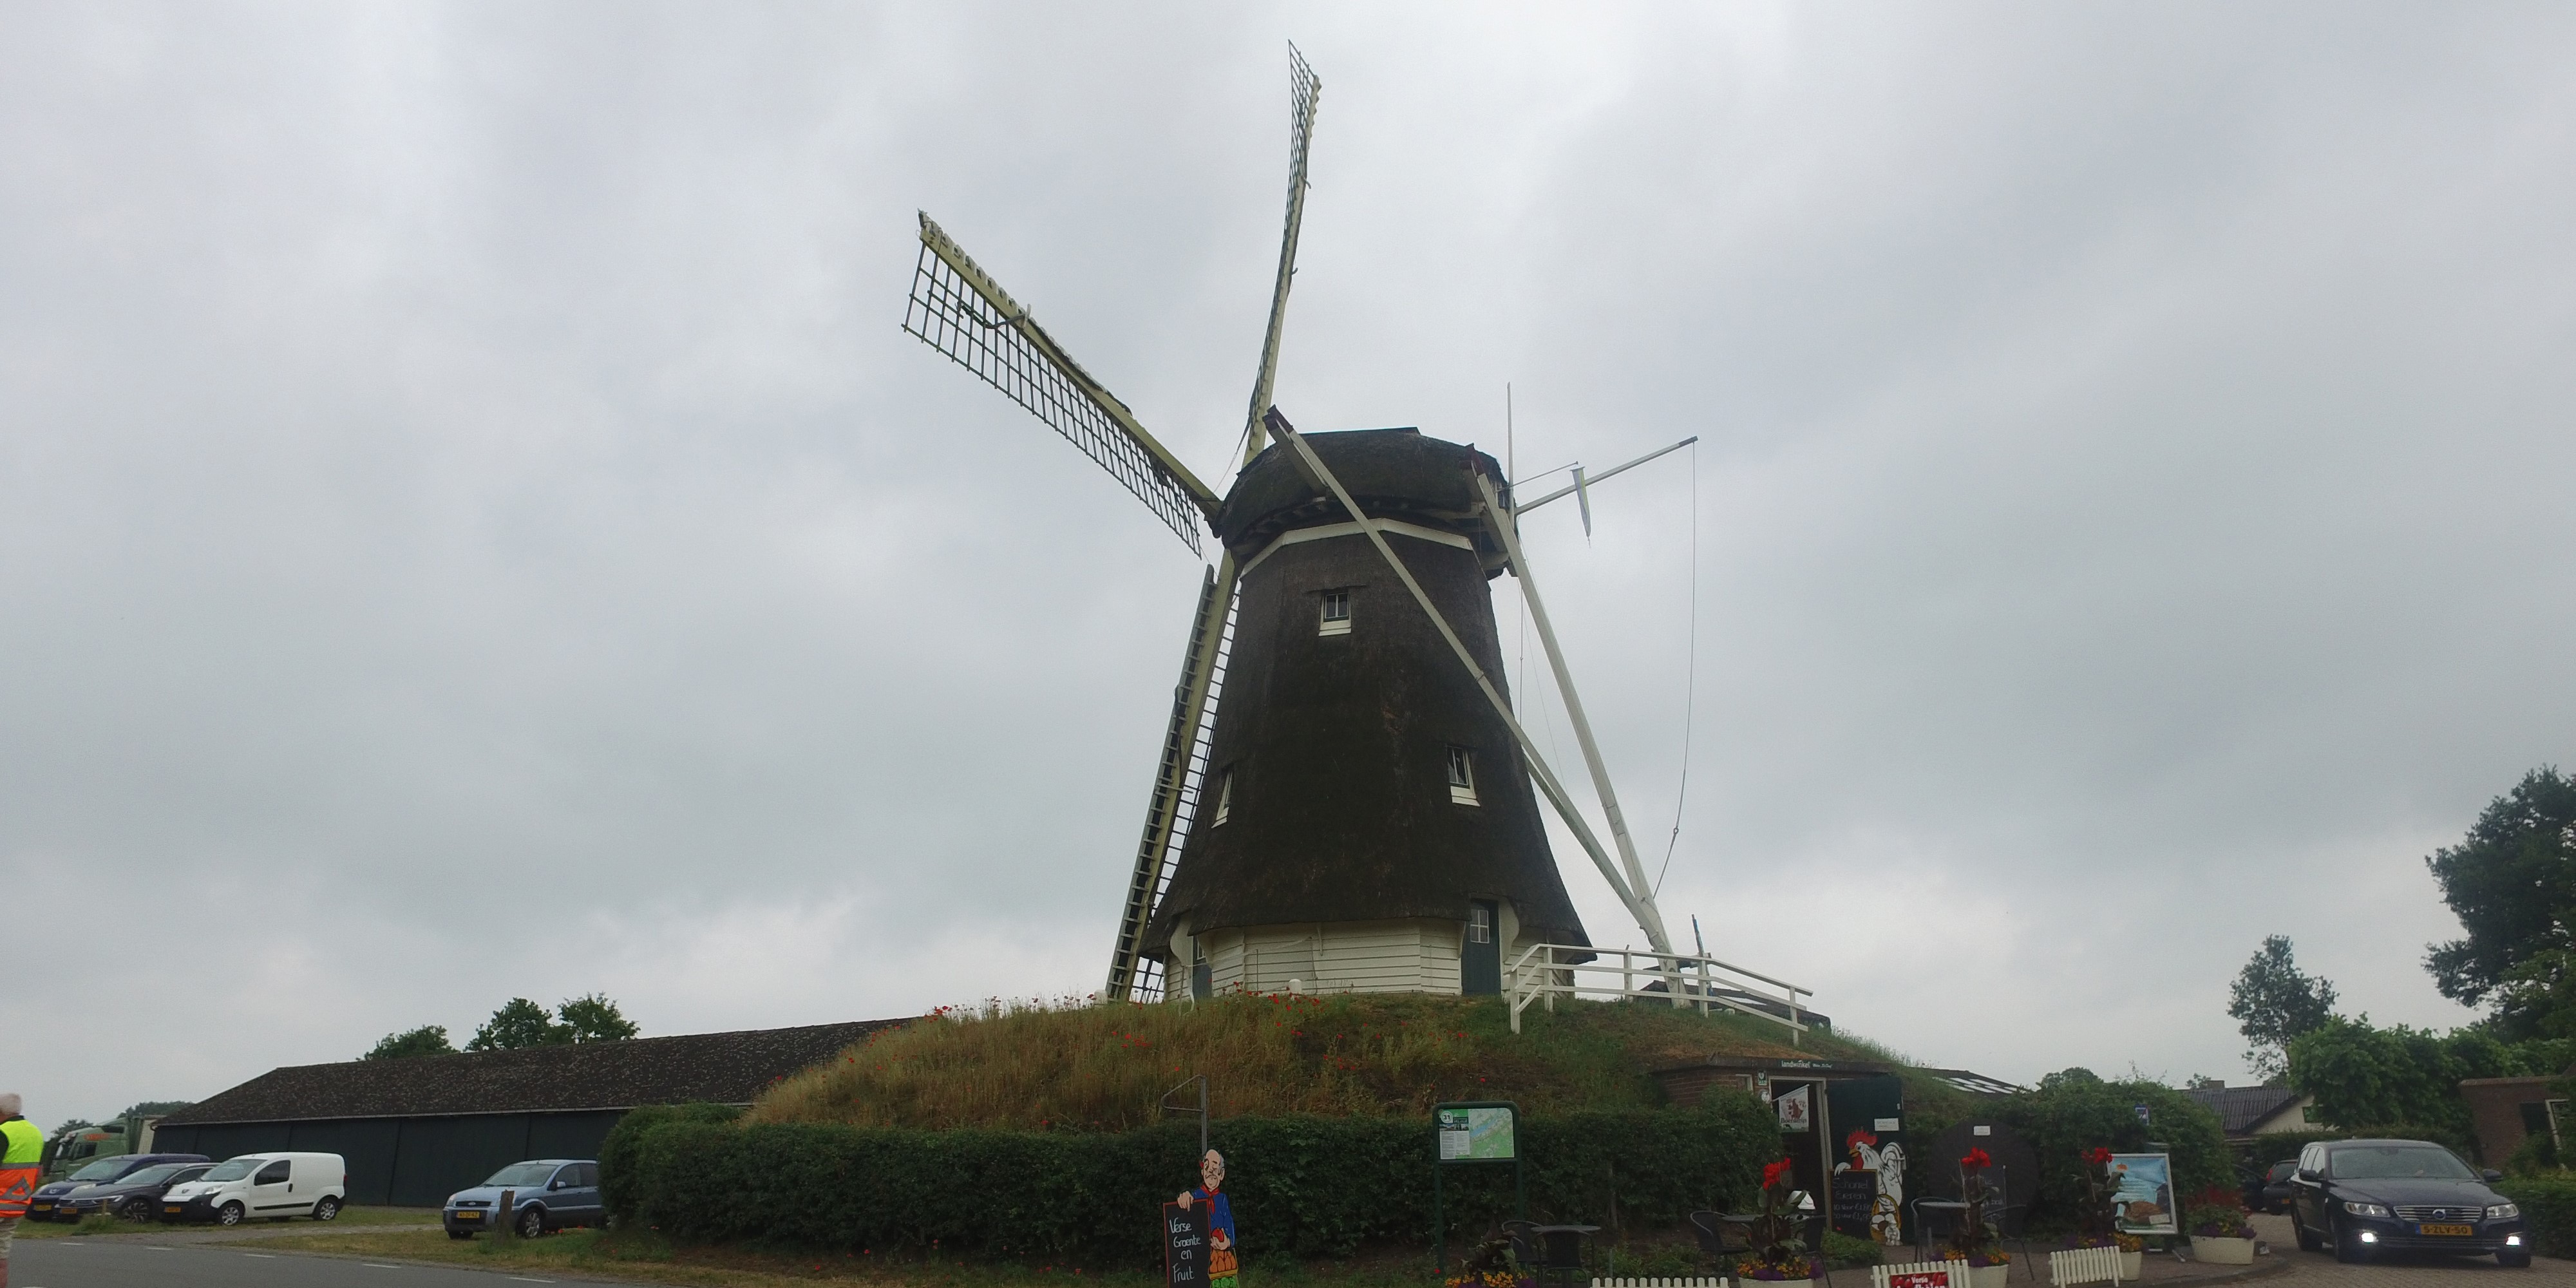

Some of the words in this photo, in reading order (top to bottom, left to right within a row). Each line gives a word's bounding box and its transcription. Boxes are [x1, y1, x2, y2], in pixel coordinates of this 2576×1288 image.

[1169, 1217, 1192, 1233] Verse
[1173, 1234, 1201, 1248] Groente
[1180, 1249, 1192, 1260] en
[1172, 1262, 1195, 1283] Fruit
